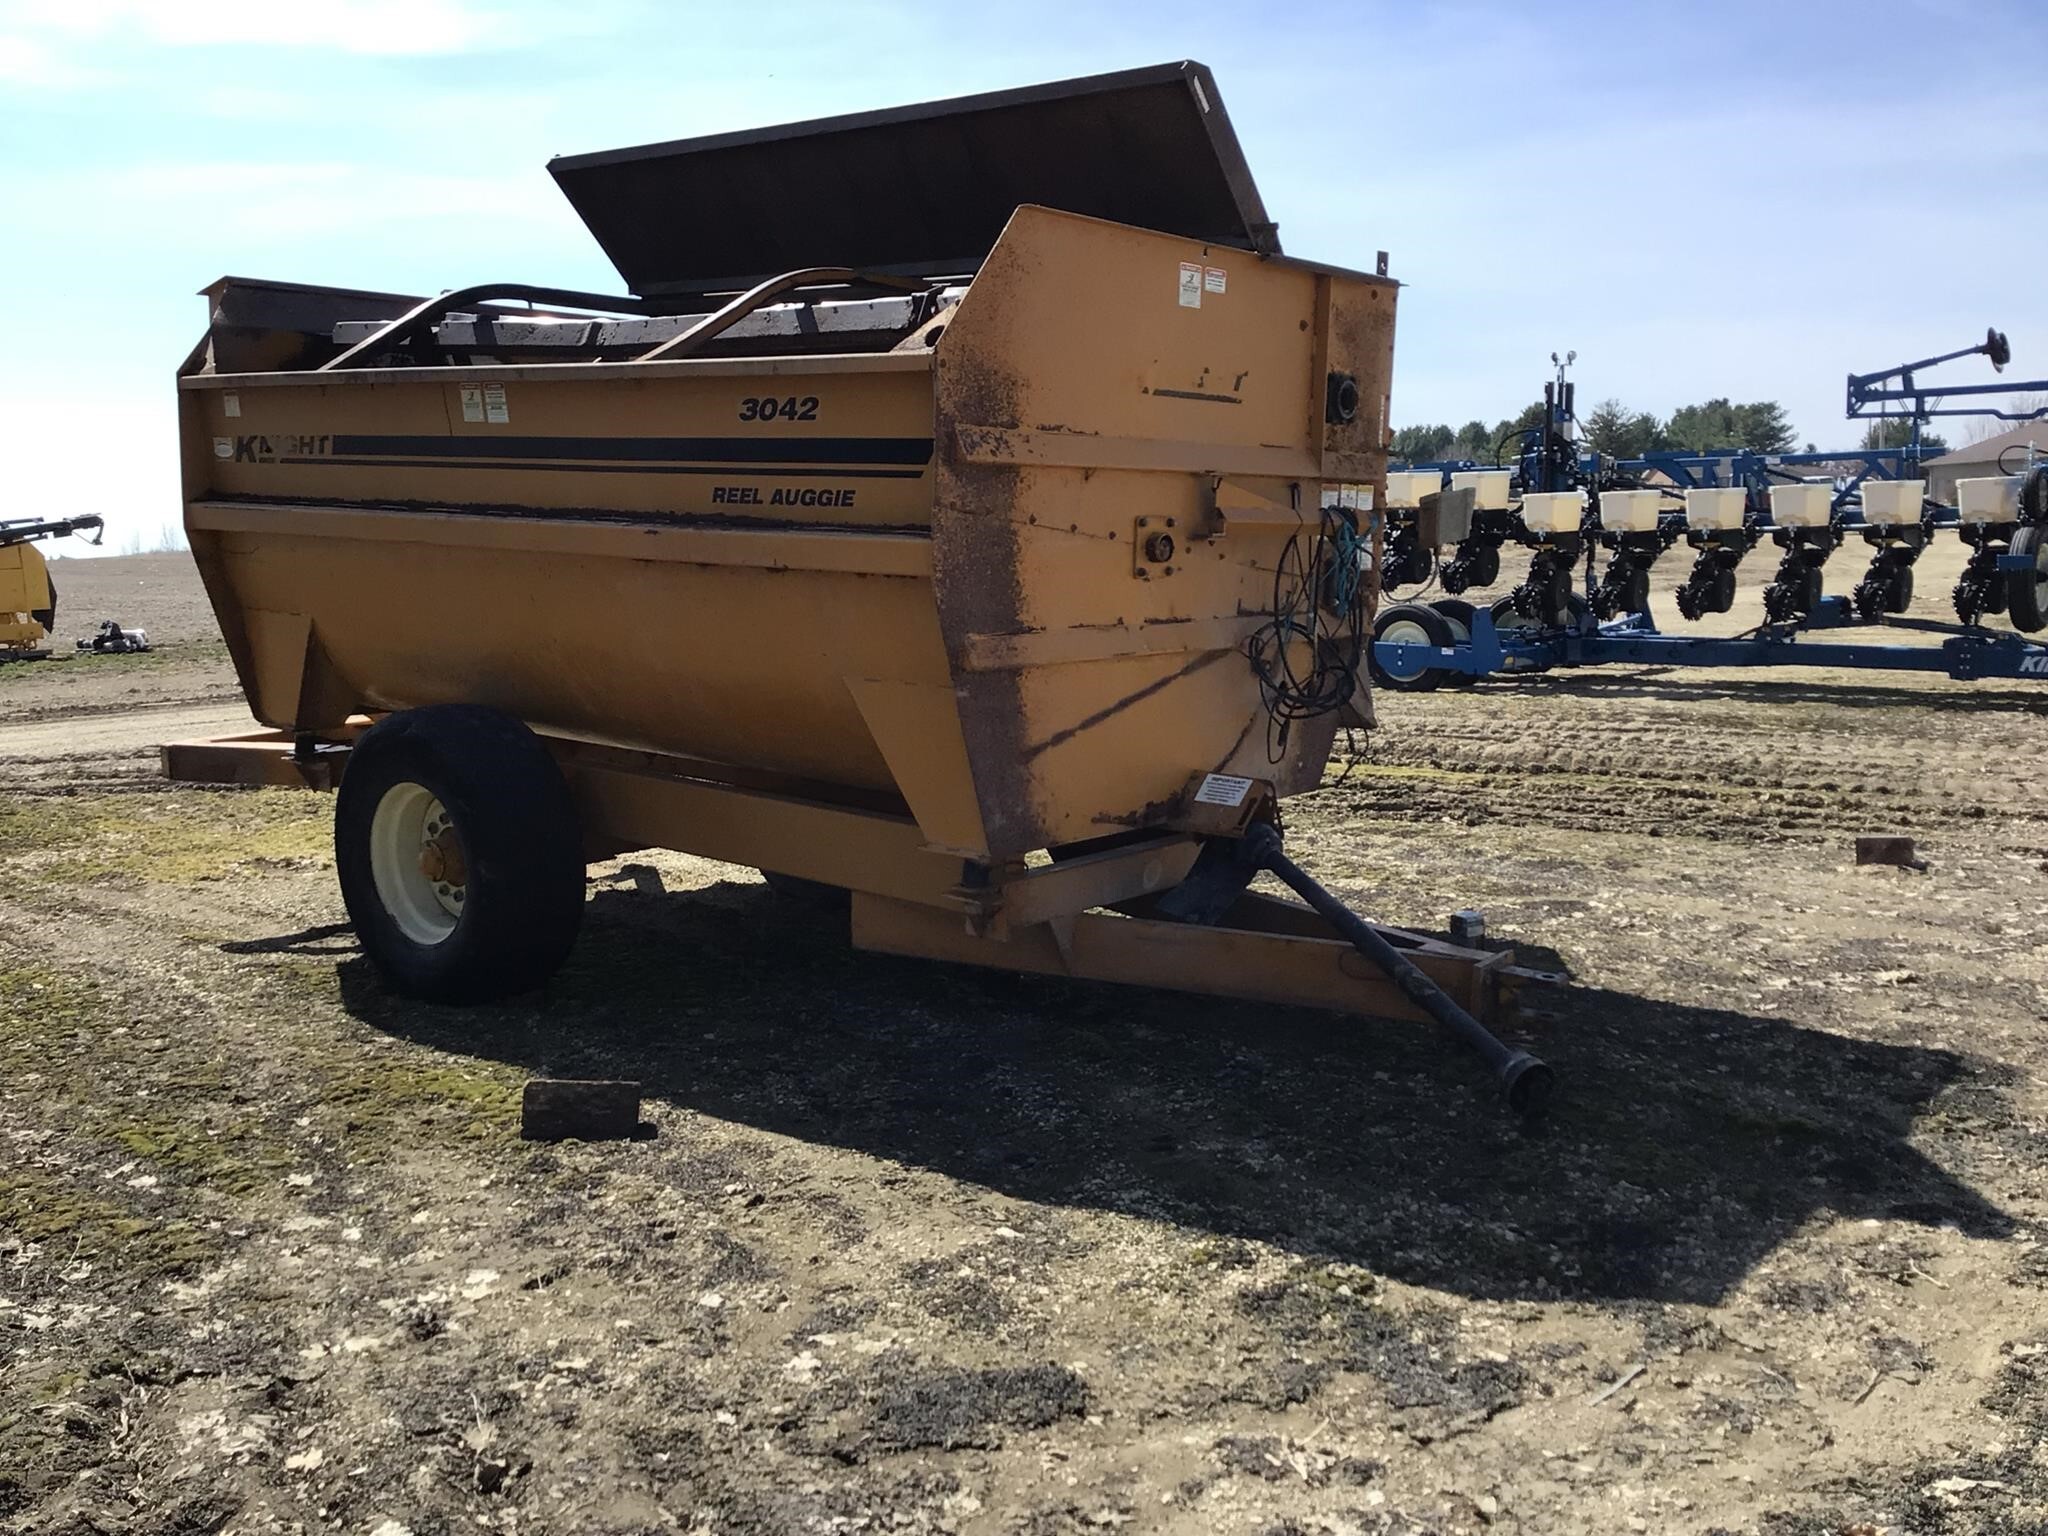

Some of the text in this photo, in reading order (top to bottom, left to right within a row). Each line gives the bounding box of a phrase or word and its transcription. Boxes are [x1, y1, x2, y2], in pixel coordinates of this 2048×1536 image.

[739, 397, 819, 421] 3042
[712, 487, 856, 507] REEL AUGGIE
